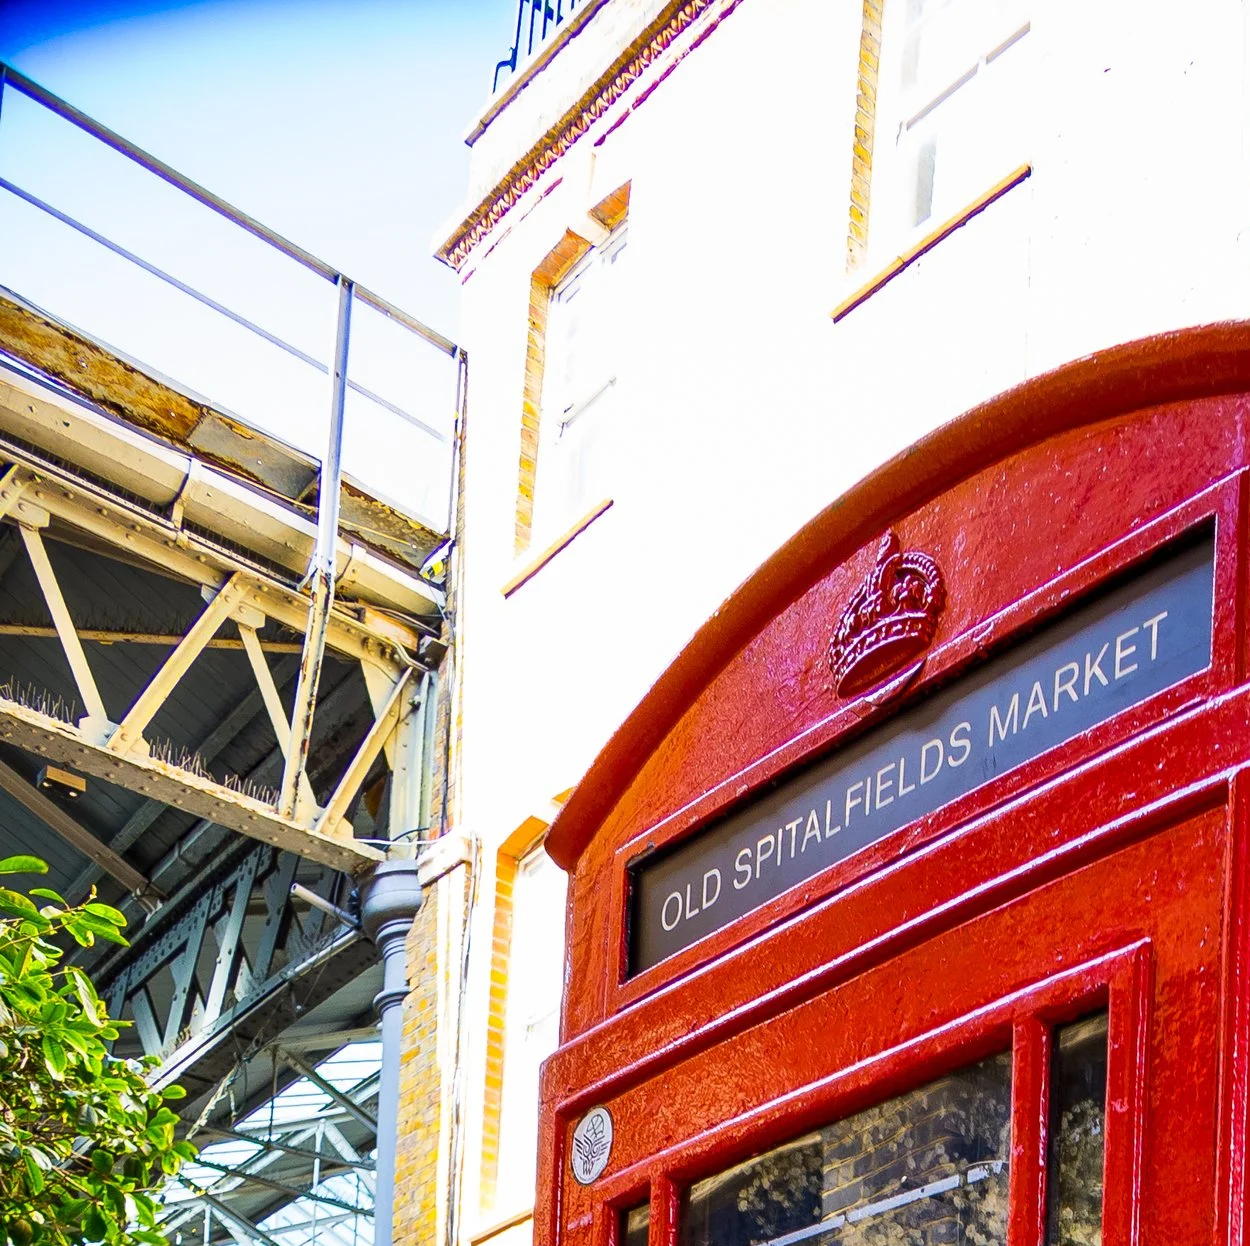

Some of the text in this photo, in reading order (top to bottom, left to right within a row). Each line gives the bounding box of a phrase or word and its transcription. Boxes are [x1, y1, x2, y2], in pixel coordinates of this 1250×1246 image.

[661, 611, 1168, 932] OLD SPITALFIELDS MARKET
